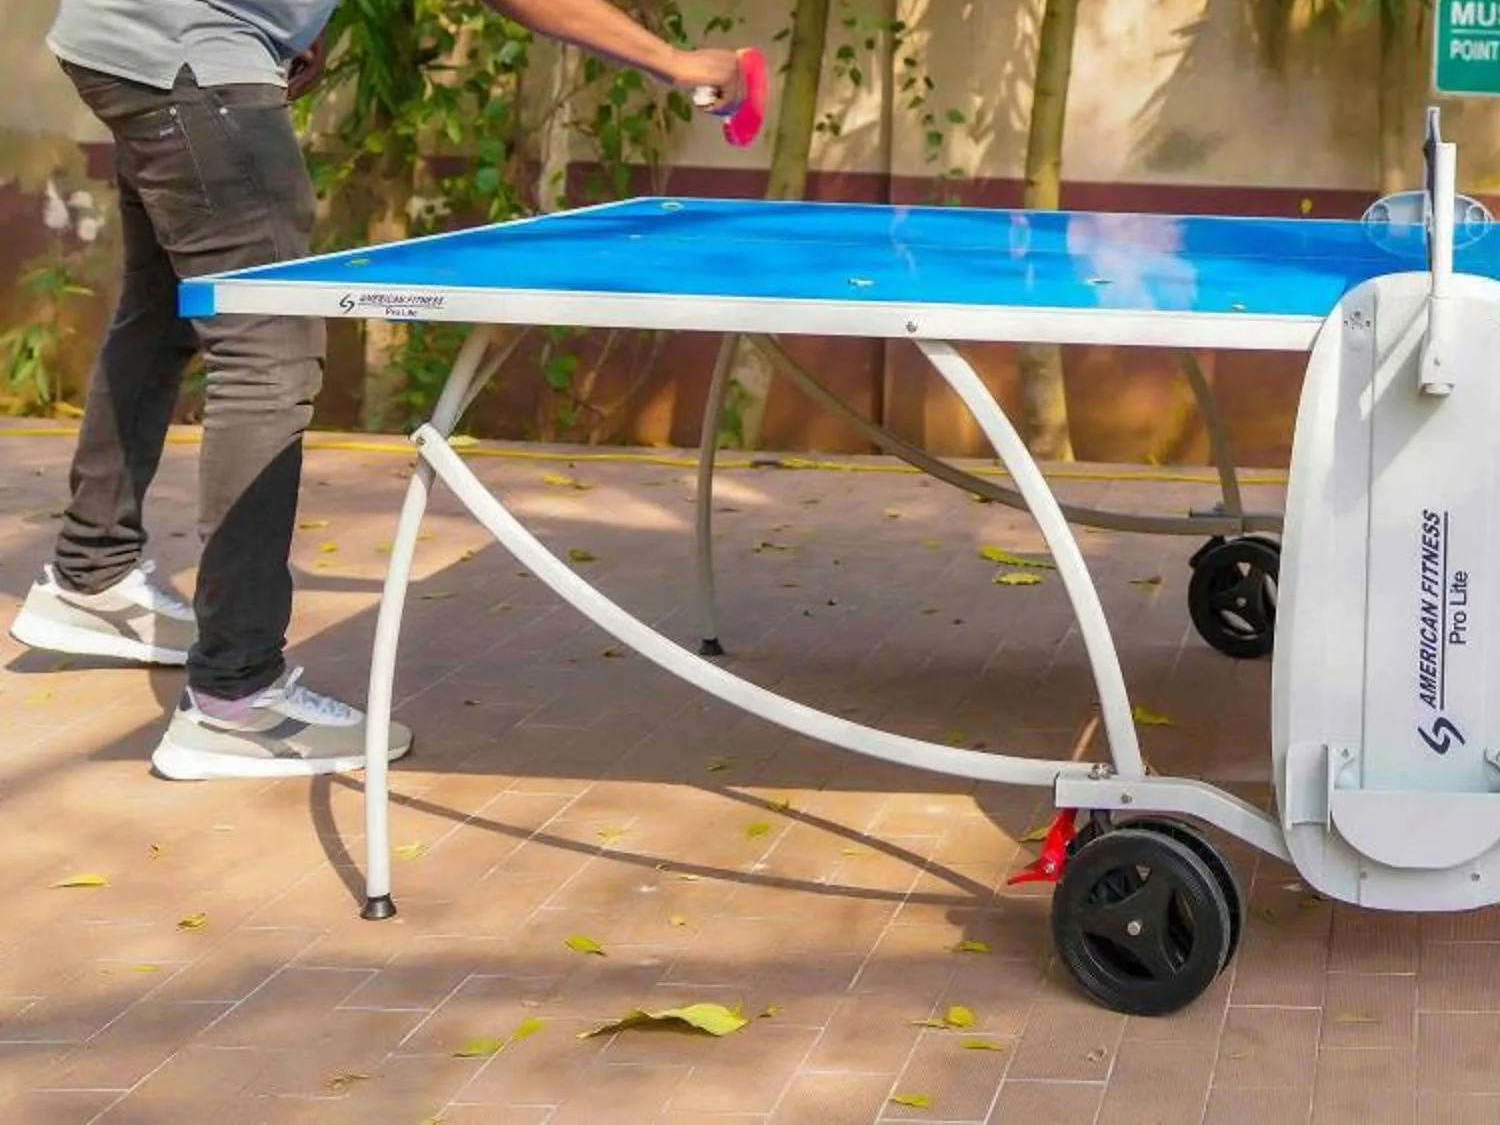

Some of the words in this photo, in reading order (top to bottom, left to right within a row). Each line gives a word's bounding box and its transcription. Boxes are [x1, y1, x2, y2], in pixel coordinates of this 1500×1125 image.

[1451, 40, 1499, 61] POINT
[1421, 509, 1441, 598] FITNESS
[1449, 570, 1469, 607] Lite
[1449, 611, 1467, 645] Pro
[1418, 599, 1439, 709] AMERICAN
